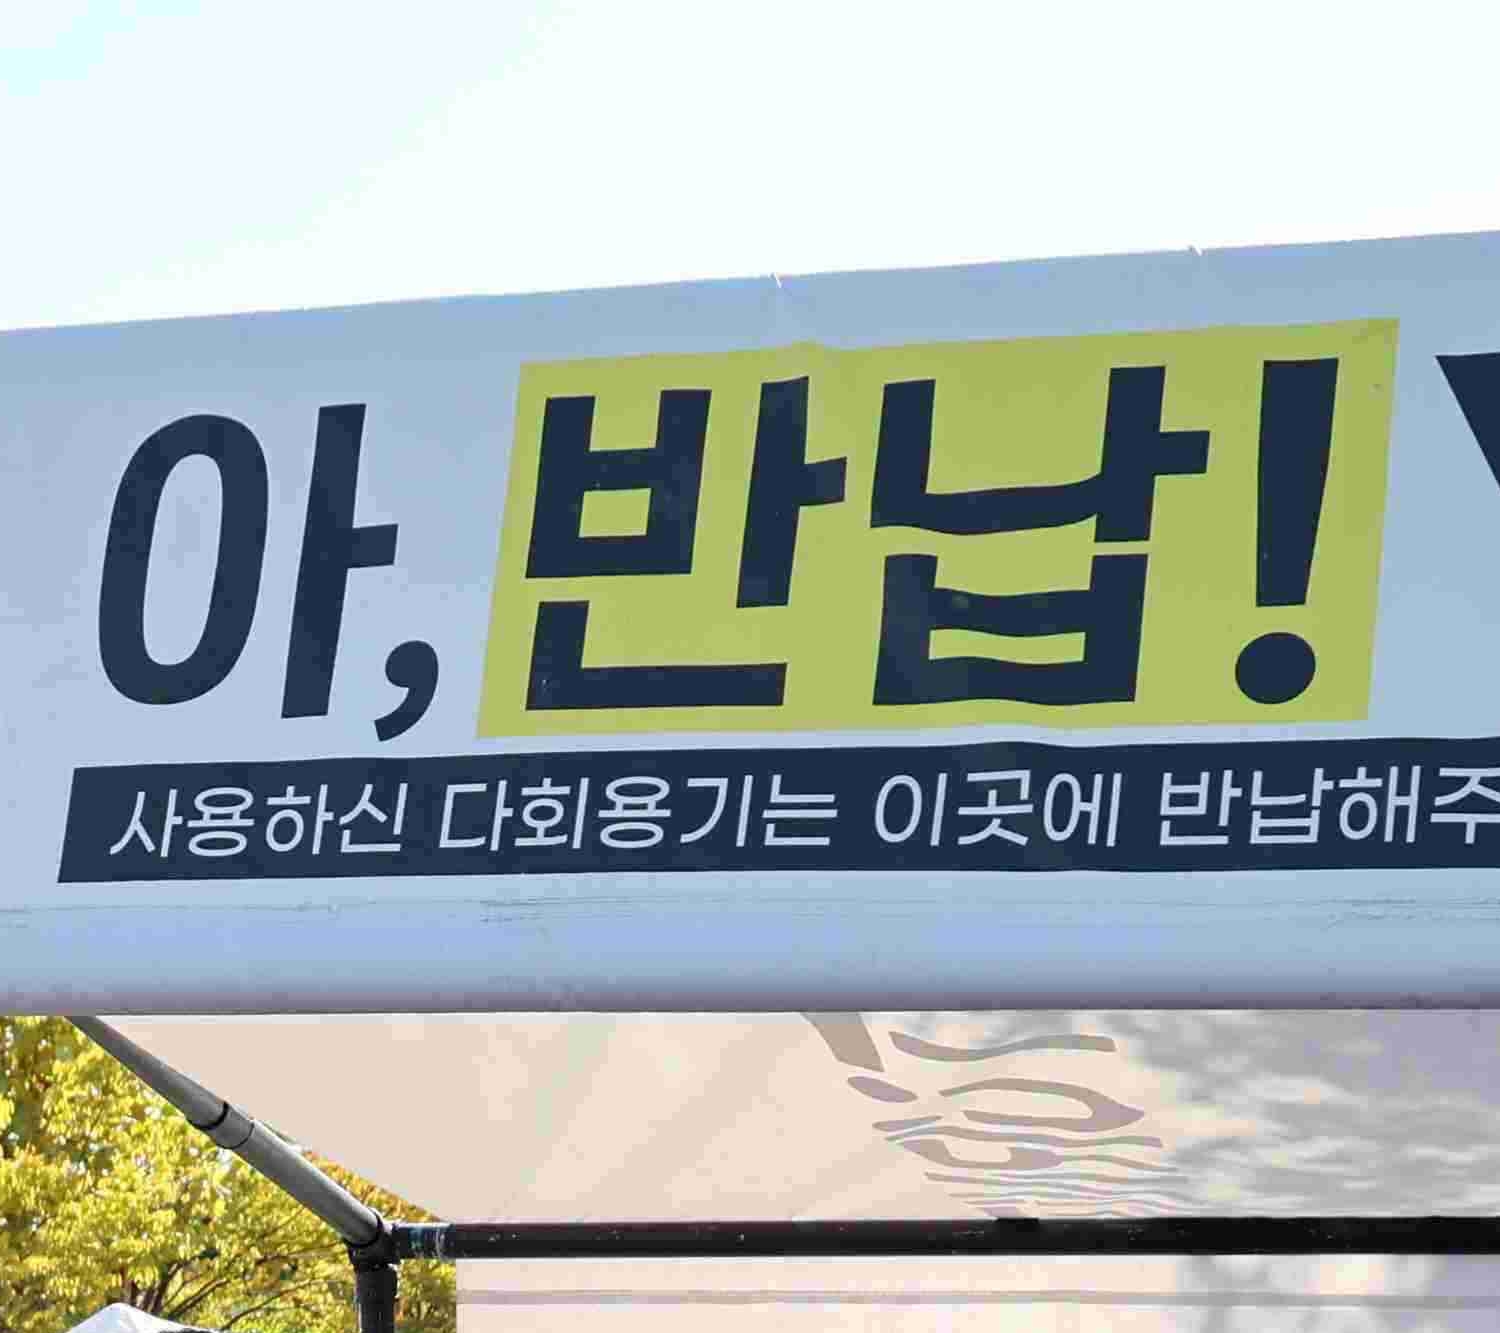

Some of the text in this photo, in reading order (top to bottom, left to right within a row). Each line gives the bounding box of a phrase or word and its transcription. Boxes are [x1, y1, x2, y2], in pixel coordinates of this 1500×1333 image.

[98, 357, 1340, 742] 아, 반납!
[108, 782, 408, 857] 사용하신
[438, 775, 838, 852] 다회용기는
[874, 769, 1123, 847] 이곳에
